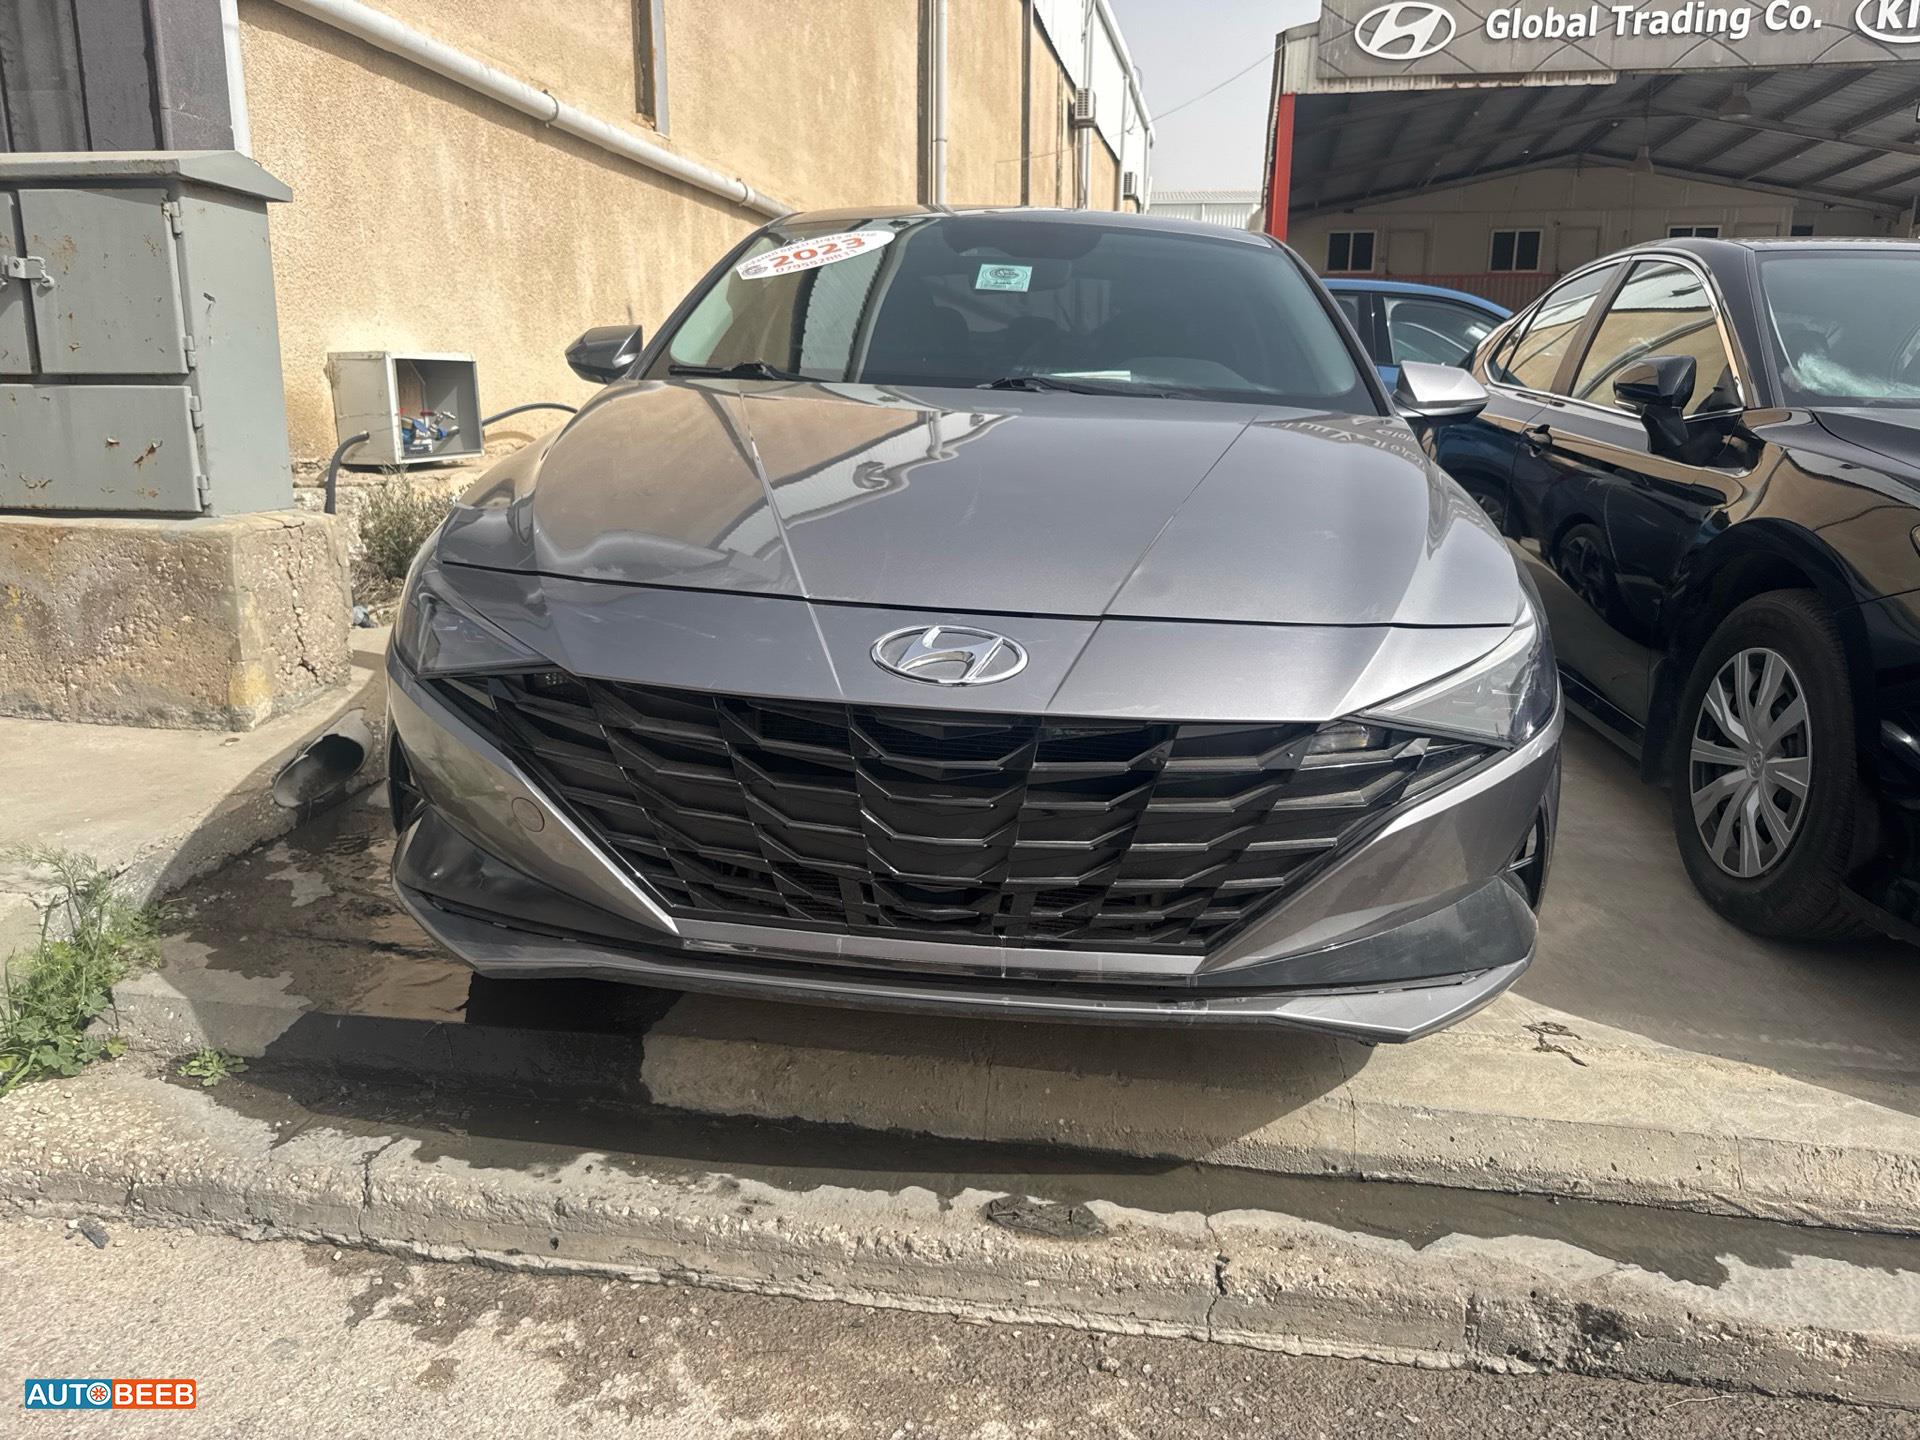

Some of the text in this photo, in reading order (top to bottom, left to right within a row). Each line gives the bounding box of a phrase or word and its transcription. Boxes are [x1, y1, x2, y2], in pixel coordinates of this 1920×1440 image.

[1486, 0, 1822, 40] Global Trading Co.
[1876, 0, 1920, 30] KI
[769, 237, 866, 268] 2023
